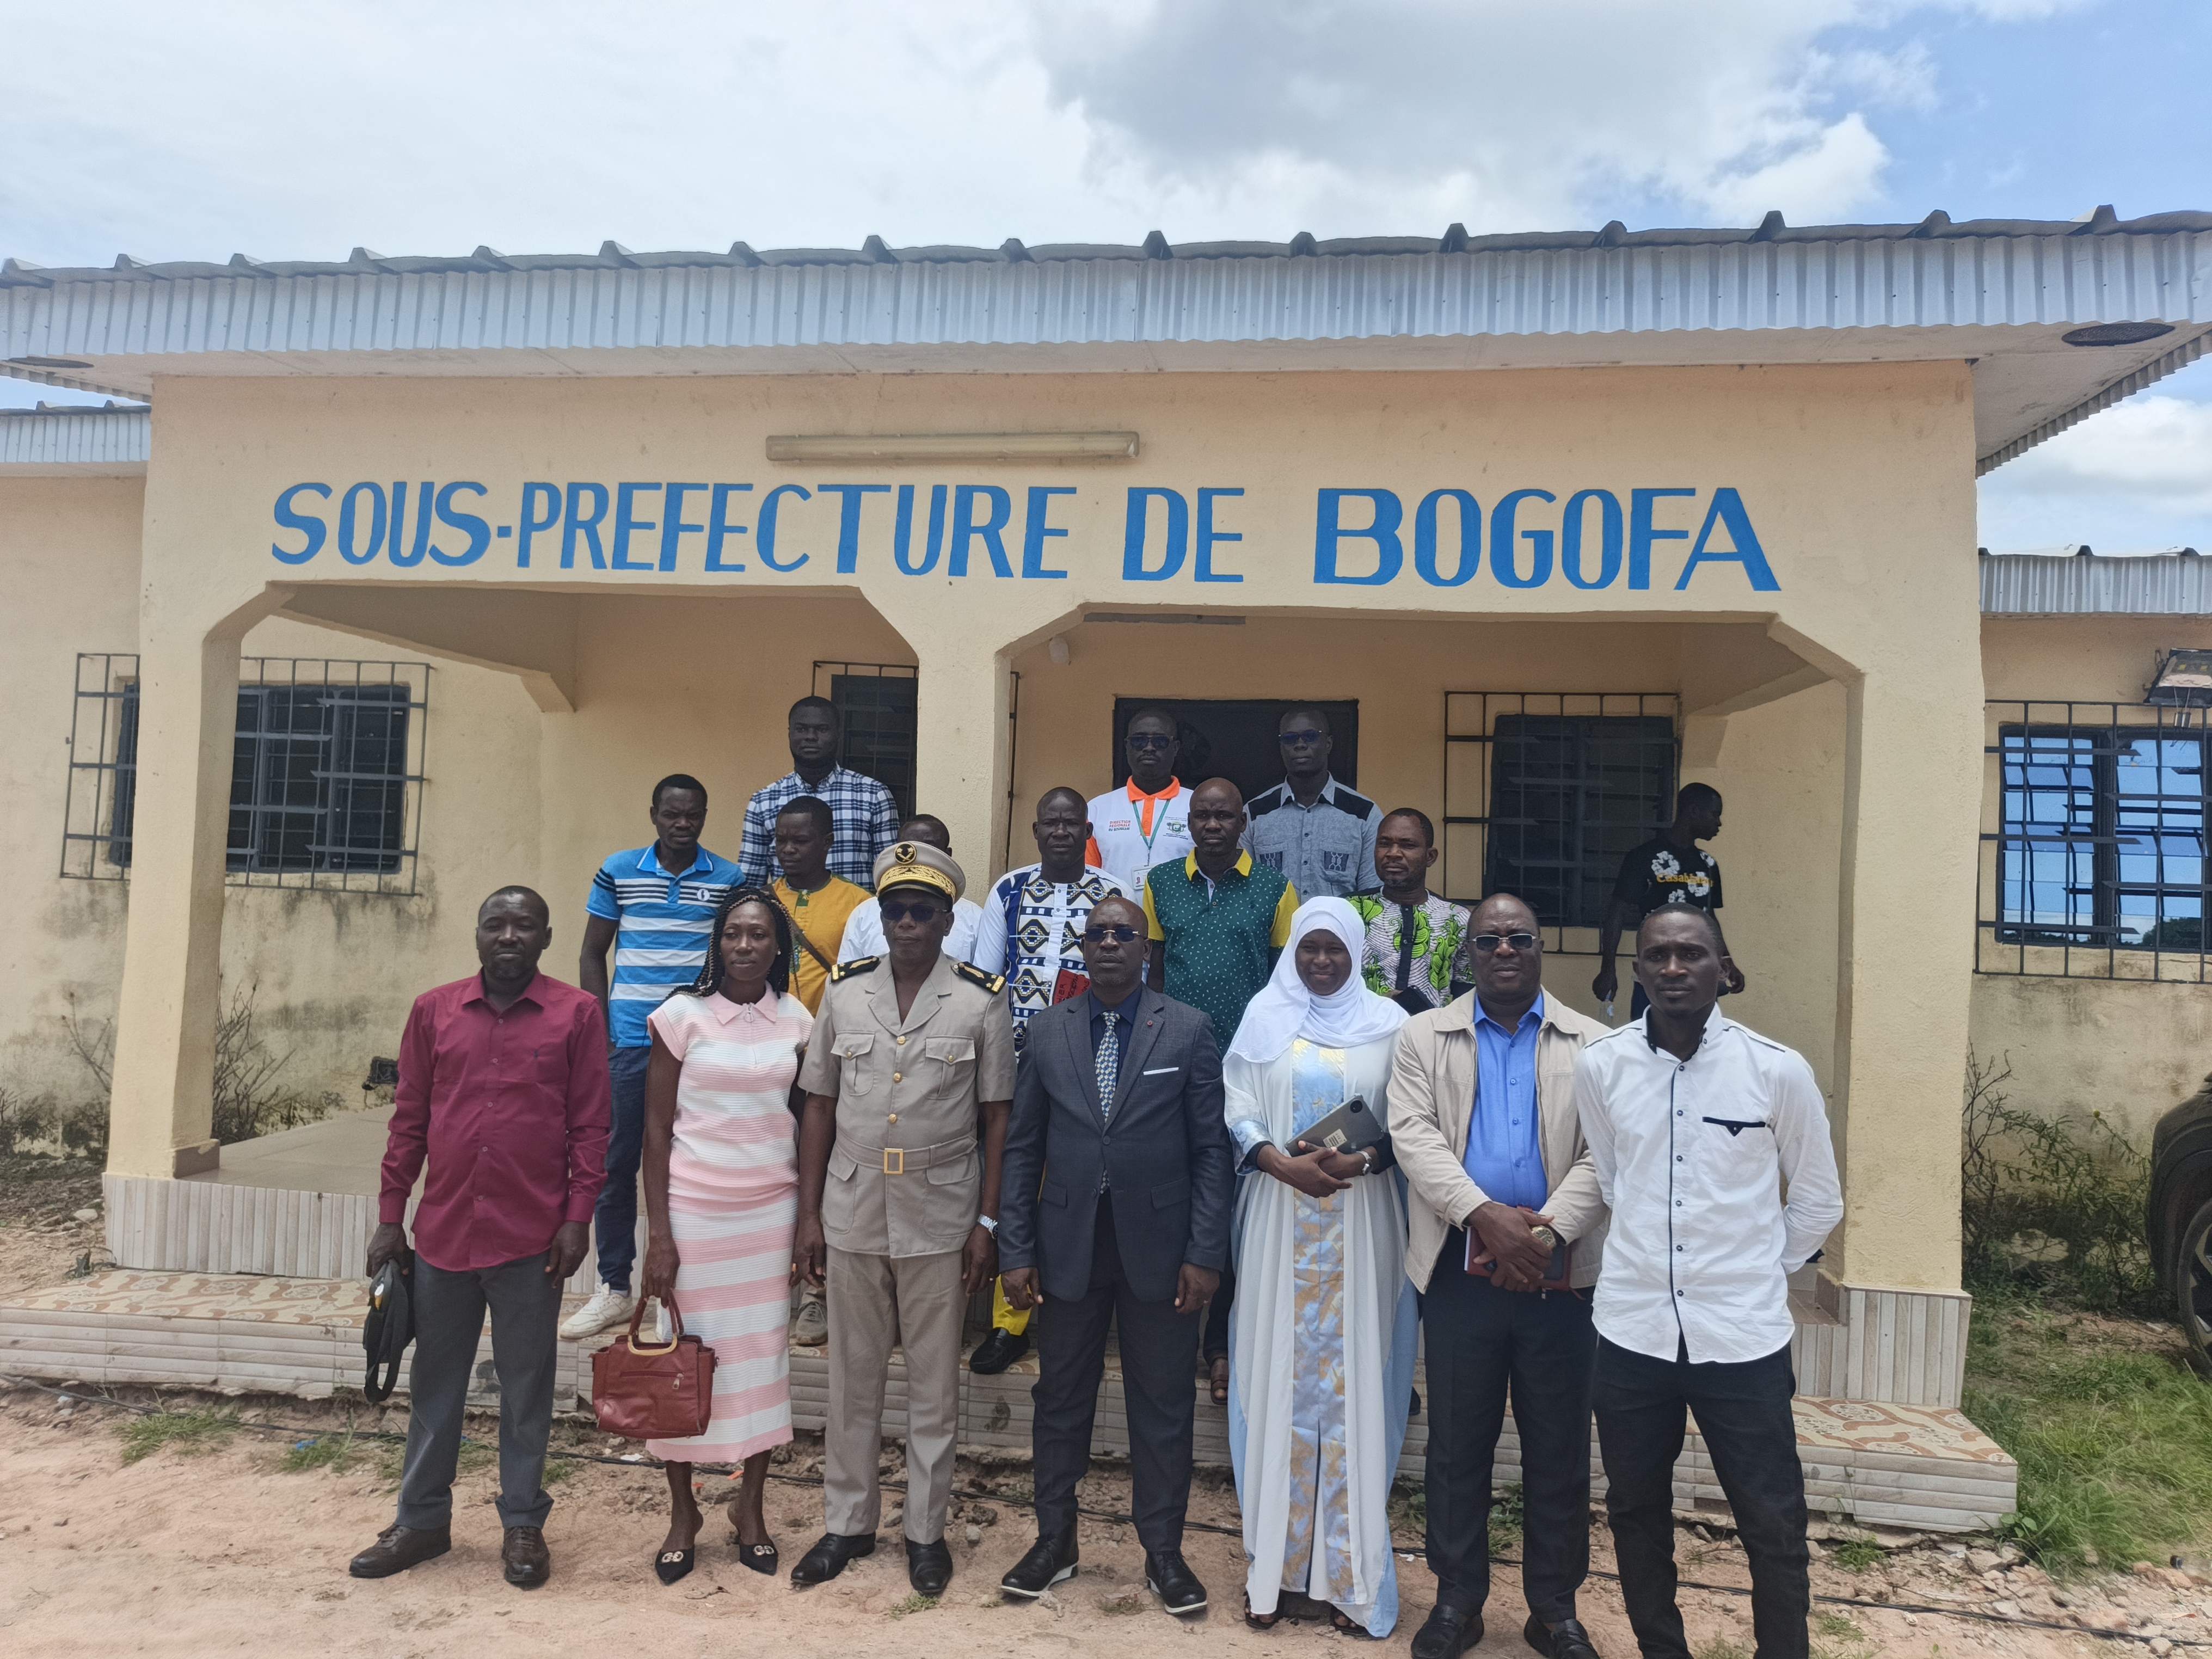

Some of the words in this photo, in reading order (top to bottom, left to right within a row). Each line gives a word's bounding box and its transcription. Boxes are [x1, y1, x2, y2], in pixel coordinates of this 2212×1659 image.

[273, 482, 1077, 581] SOUS-PREFECTURE
[1123, 488, 1244, 583] DE
[1314, 488, 1781, 591] BOGOFA
